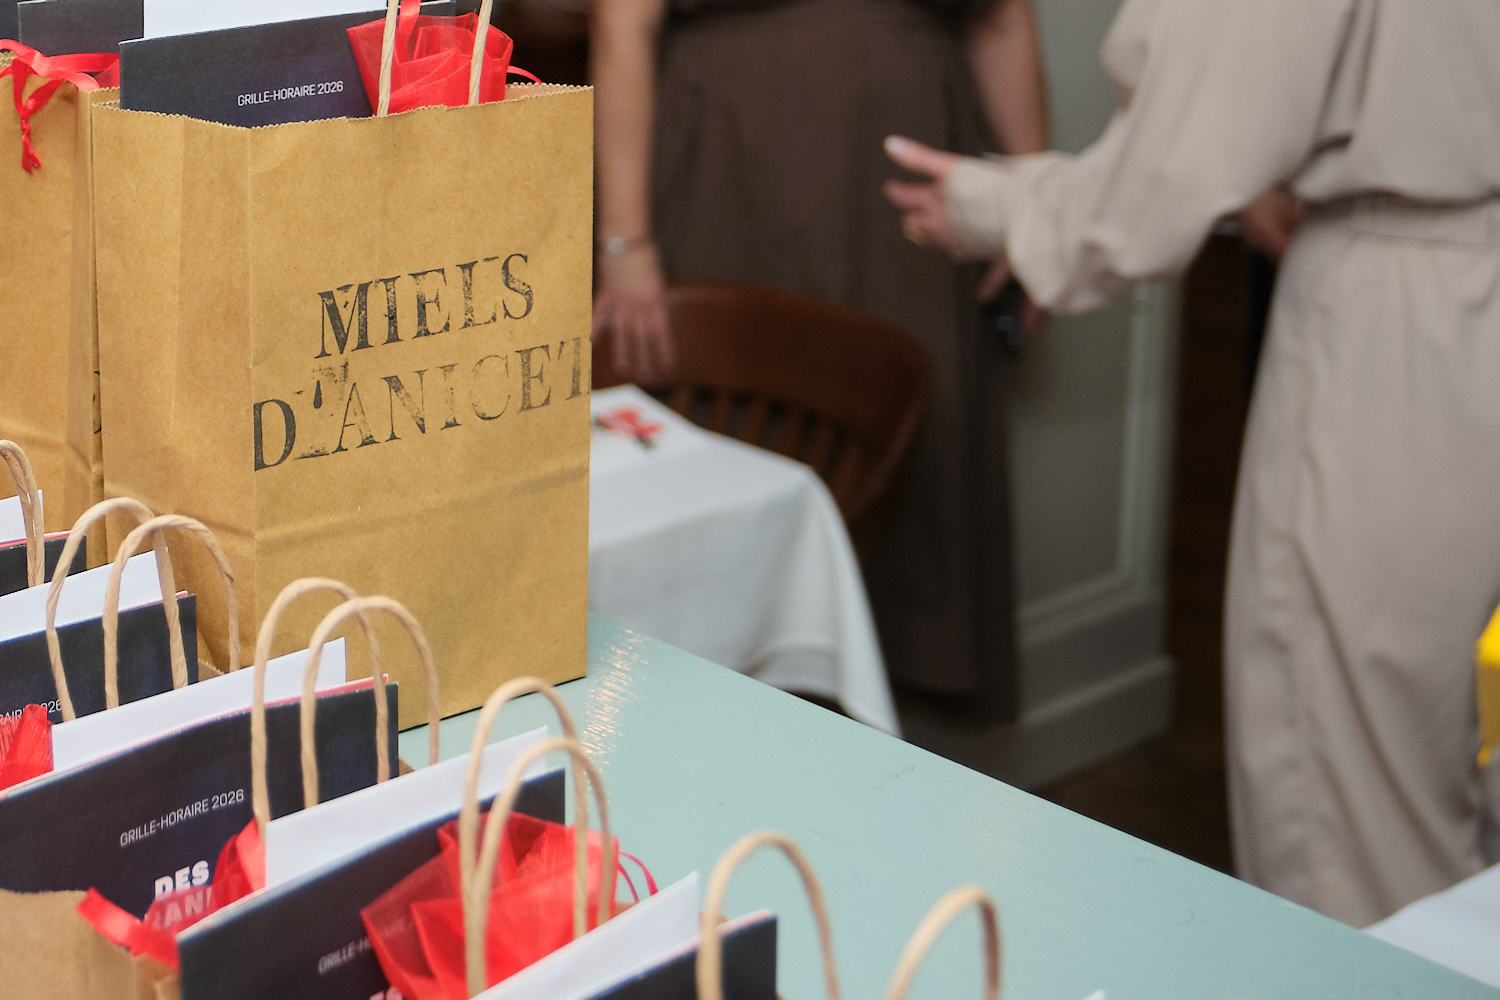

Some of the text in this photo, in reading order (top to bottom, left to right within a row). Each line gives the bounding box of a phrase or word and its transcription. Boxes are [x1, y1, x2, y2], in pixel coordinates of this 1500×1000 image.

[237, 80, 344, 107] GRILLE-HORAIRE 2026
[314, 253, 535, 359] MIELS
[120, 788, 245, 847] GRILLE-HORAIRE 2026
[154, 860, 210, 901] DES
